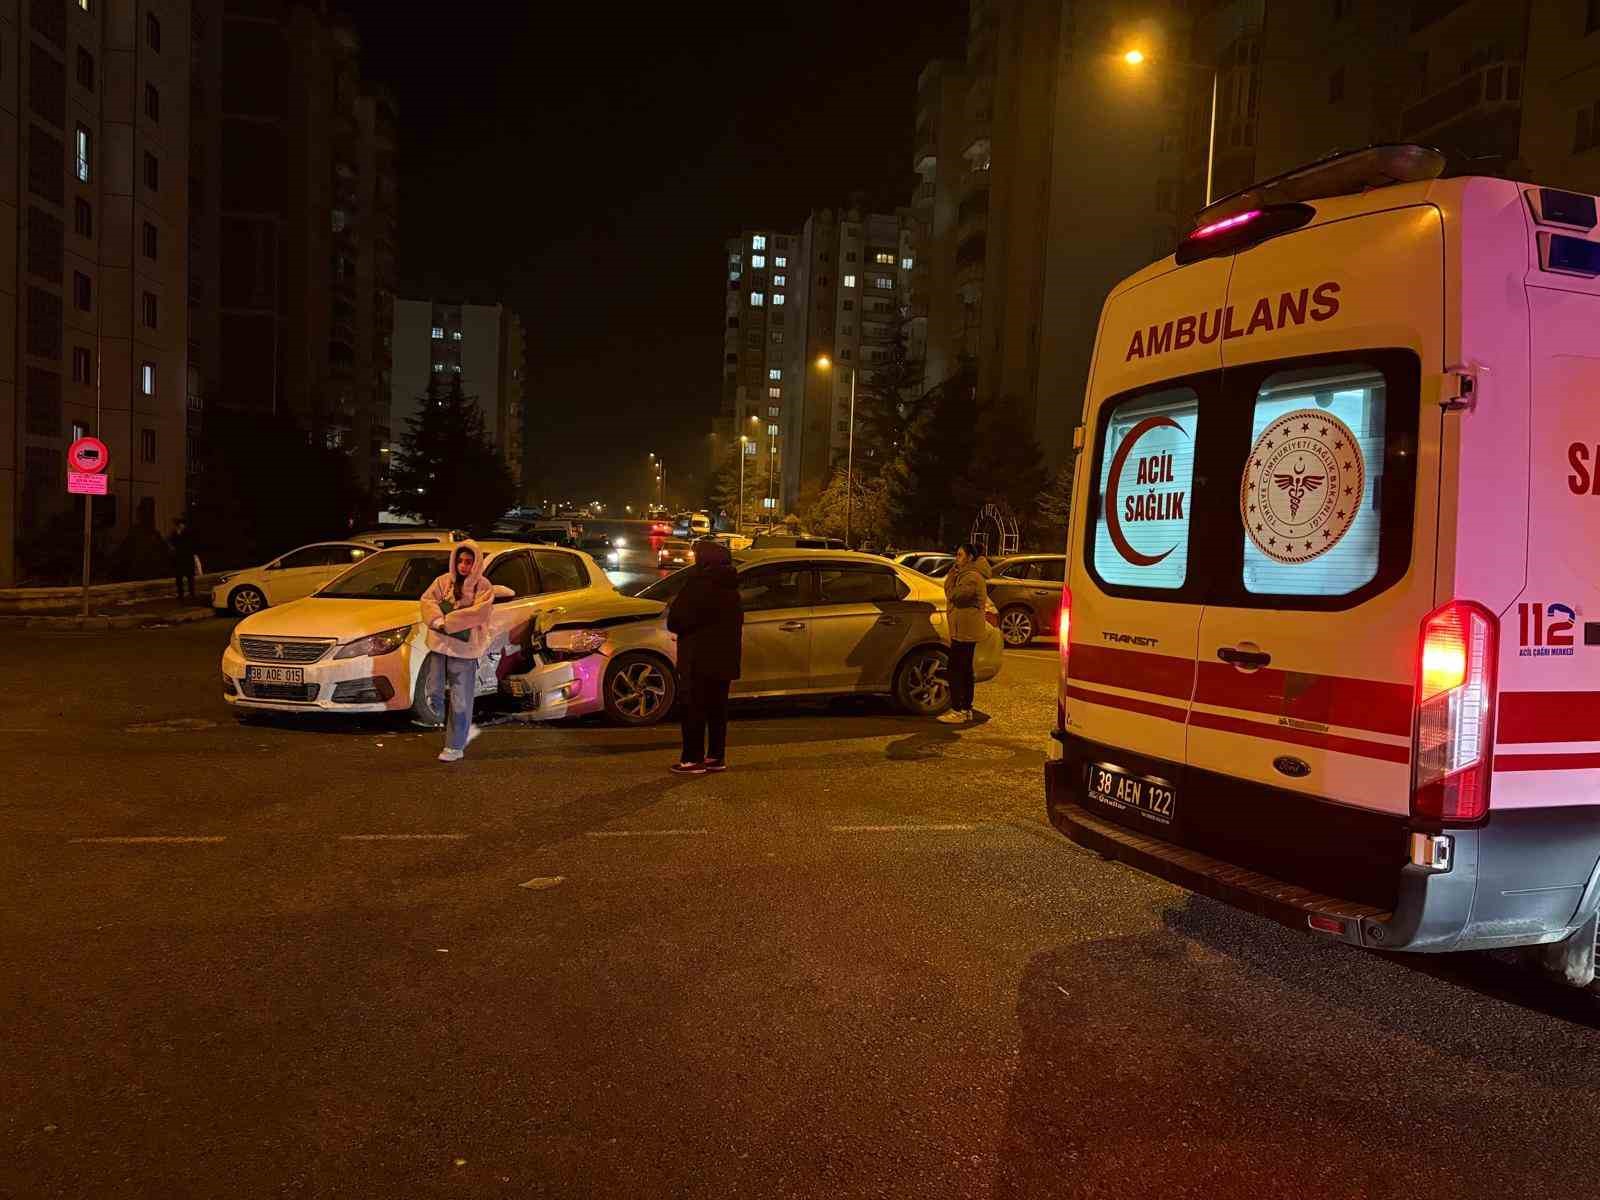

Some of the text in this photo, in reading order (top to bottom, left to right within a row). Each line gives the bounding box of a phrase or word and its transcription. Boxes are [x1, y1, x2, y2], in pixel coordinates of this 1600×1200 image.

[1125, 281, 1341, 362] AMBULANS
[1136, 449, 1174, 485] ACİL
[1311, 443, 1336, 473] SAĞLIK
[1125, 487, 1185, 522] SAĞLIK
[1102, 631, 1159, 647] TRANSIT
[1518, 603, 1576, 647] 112
[251, 668, 262, 680] 38
[285, 670, 301, 682] 015
[1097, 771, 1113, 795] 38
[1116, 777, 1142, 806] AEN
[1148, 787, 1172, 817] 122
